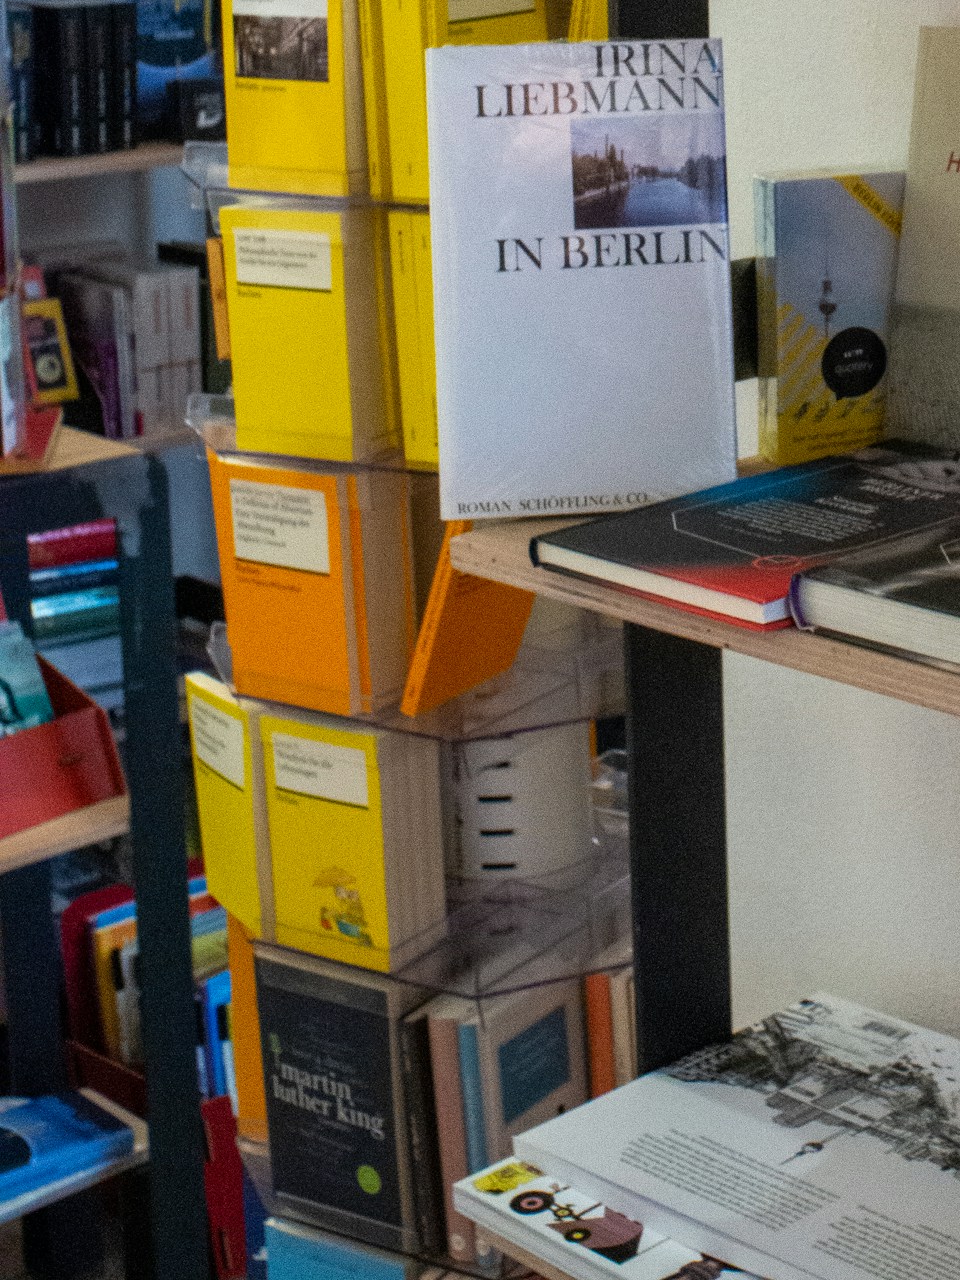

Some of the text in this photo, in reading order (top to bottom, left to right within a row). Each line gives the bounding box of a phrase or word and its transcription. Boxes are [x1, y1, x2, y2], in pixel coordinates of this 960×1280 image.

[592, 40, 720, 78] IRINA
[474, 75, 723, 119] LIEBMANN
[495, 228, 729, 273] IN BERLIN
[457, 499, 512, 515] ROMAN
[518, 493, 611, 512] SCHÖFFLING
[610, 495, 622, 506] &
[280, 1062, 352, 1101] martin
[337, 1095, 386, 1141] king
